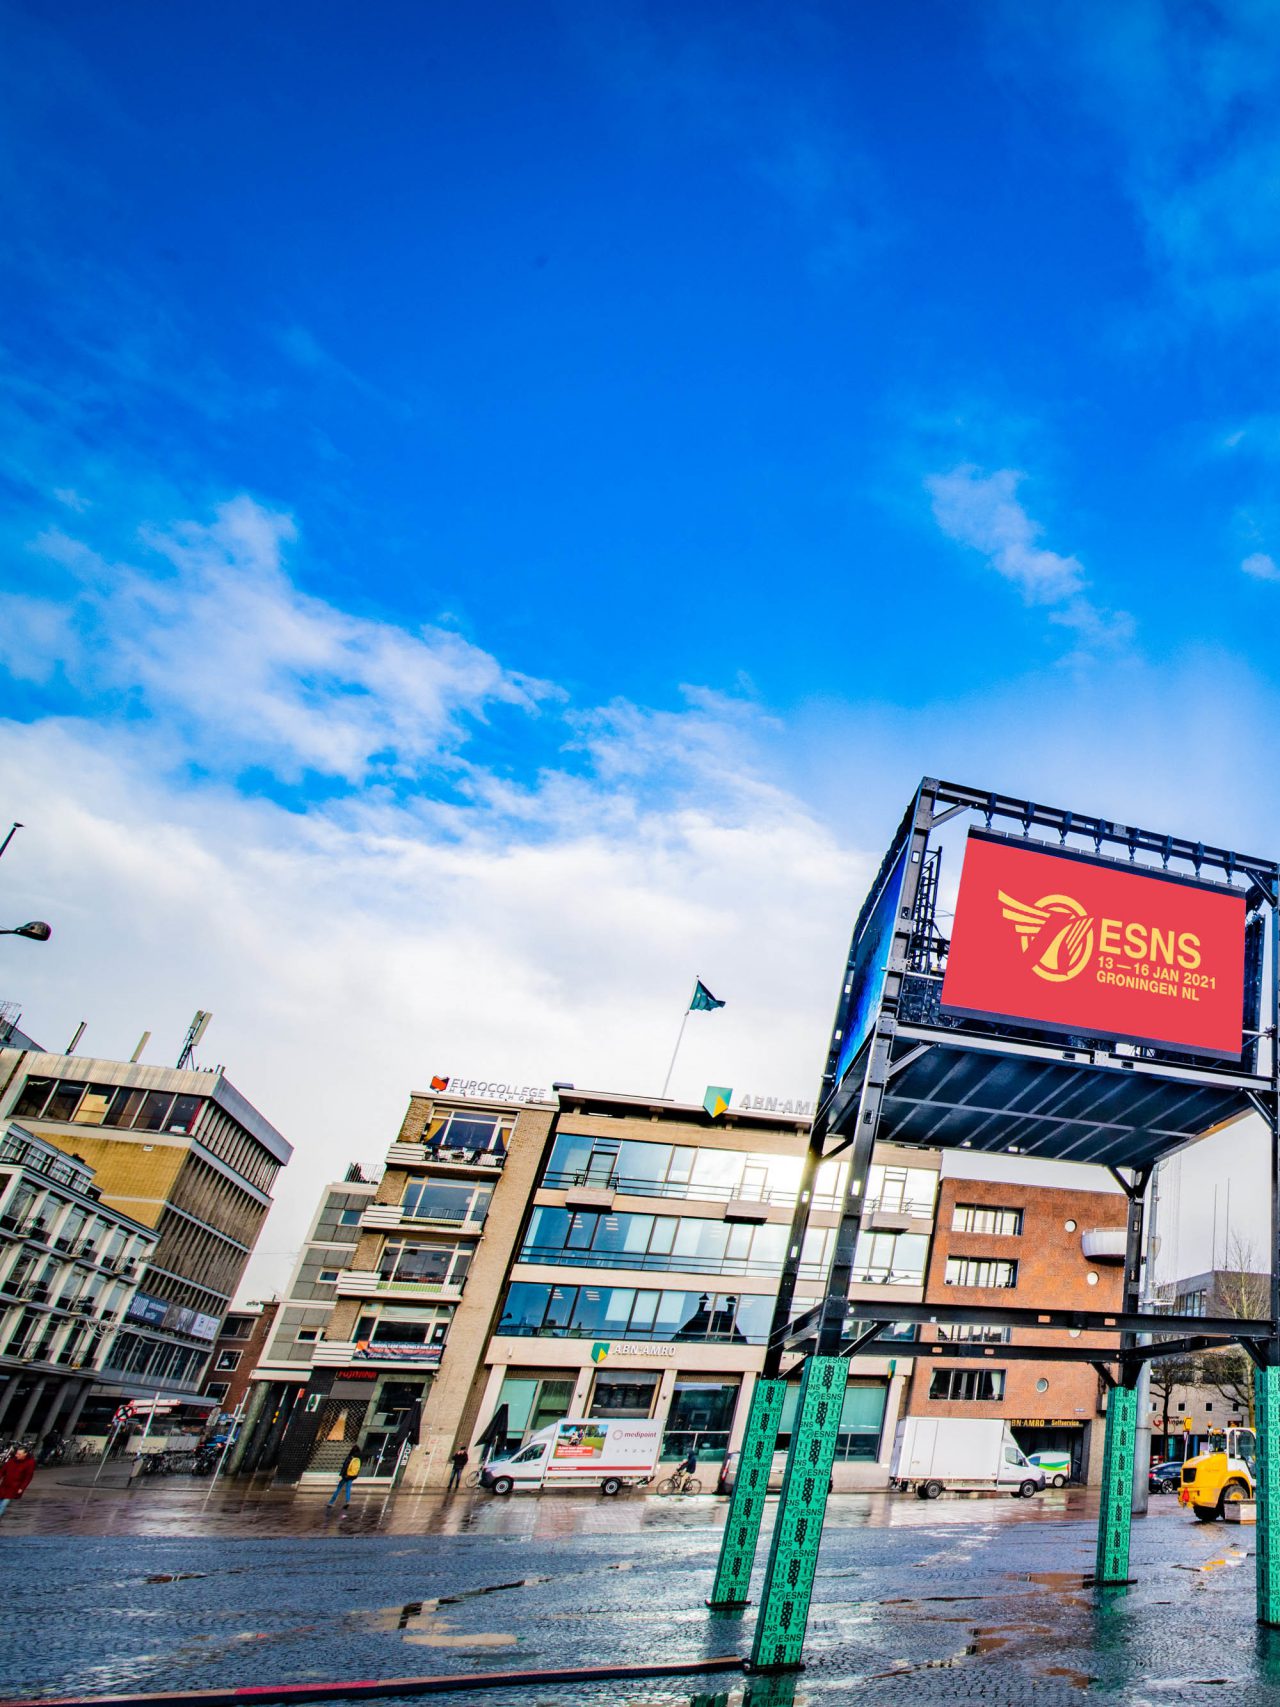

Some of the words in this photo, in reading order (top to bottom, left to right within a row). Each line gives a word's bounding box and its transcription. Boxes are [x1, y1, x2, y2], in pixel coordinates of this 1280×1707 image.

[1099, 918, 1202, 970] ESNS
[1097, 956, 1114, 970] 13
[1133, 962, 1150, 977] 16
[1153, 966, 1180, 982] JAN
[1184, 971, 1217, 989] 2021
[1096, 970, 1178, 997] GRONINGEN
[1181, 985, 1200, 1001] NL
[451, 1078, 547, 1098] EUROCOLLEGE
[624, 1431, 657, 1439] medipoint
[814, 1430, 836, 1438] ESNS
[793, 1459, 807, 1467] SNS
[807, 1468, 830, 1476] ESNS
[792, 1549, 816, 1558] ESNS
[786, 1591, 809, 1599] ESNS
[778, 1634, 802, 1642] ESNS
